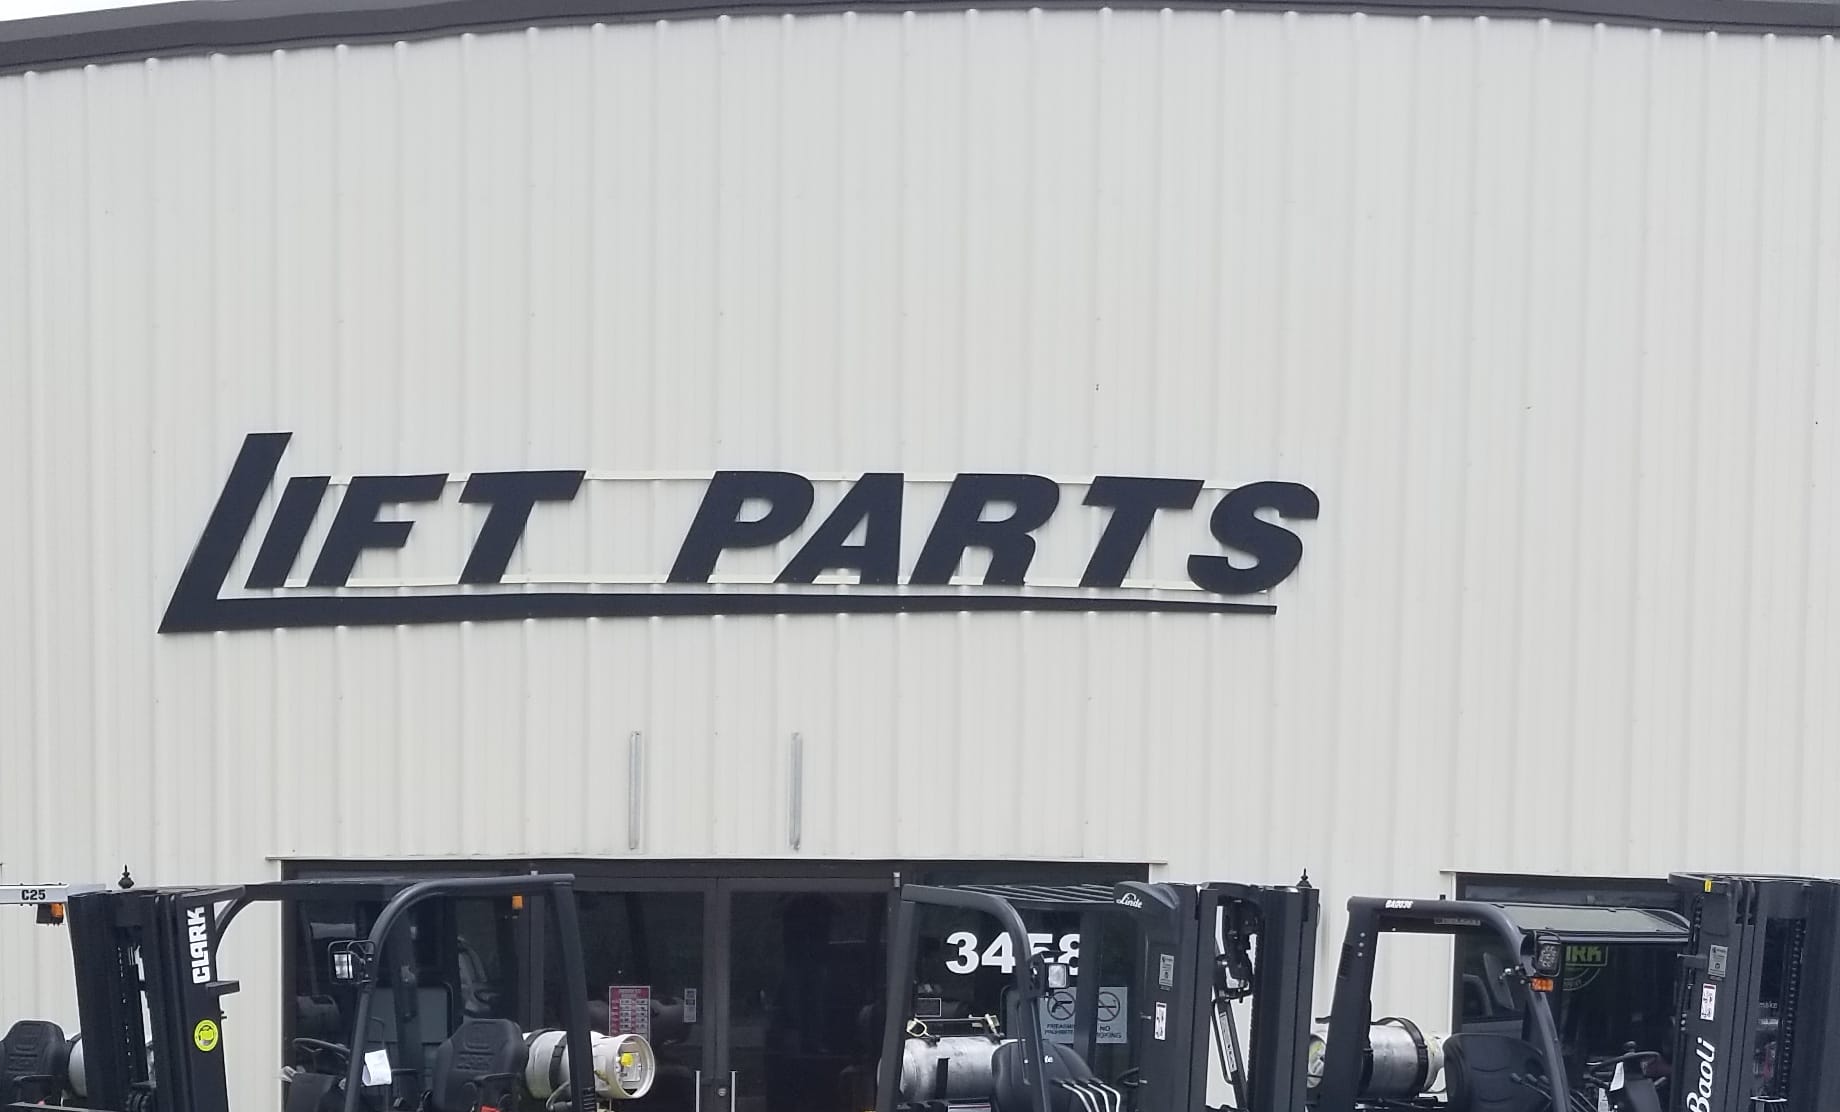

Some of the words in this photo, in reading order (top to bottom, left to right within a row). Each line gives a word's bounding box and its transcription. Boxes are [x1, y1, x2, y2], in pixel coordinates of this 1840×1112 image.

[158, 431, 586, 635] LIFT
[666, 470, 1320, 595] PARTS
[21, 889, 46, 901] C25
[1115, 892, 1143, 909] Linde
[187, 906, 211, 985] CLARK
